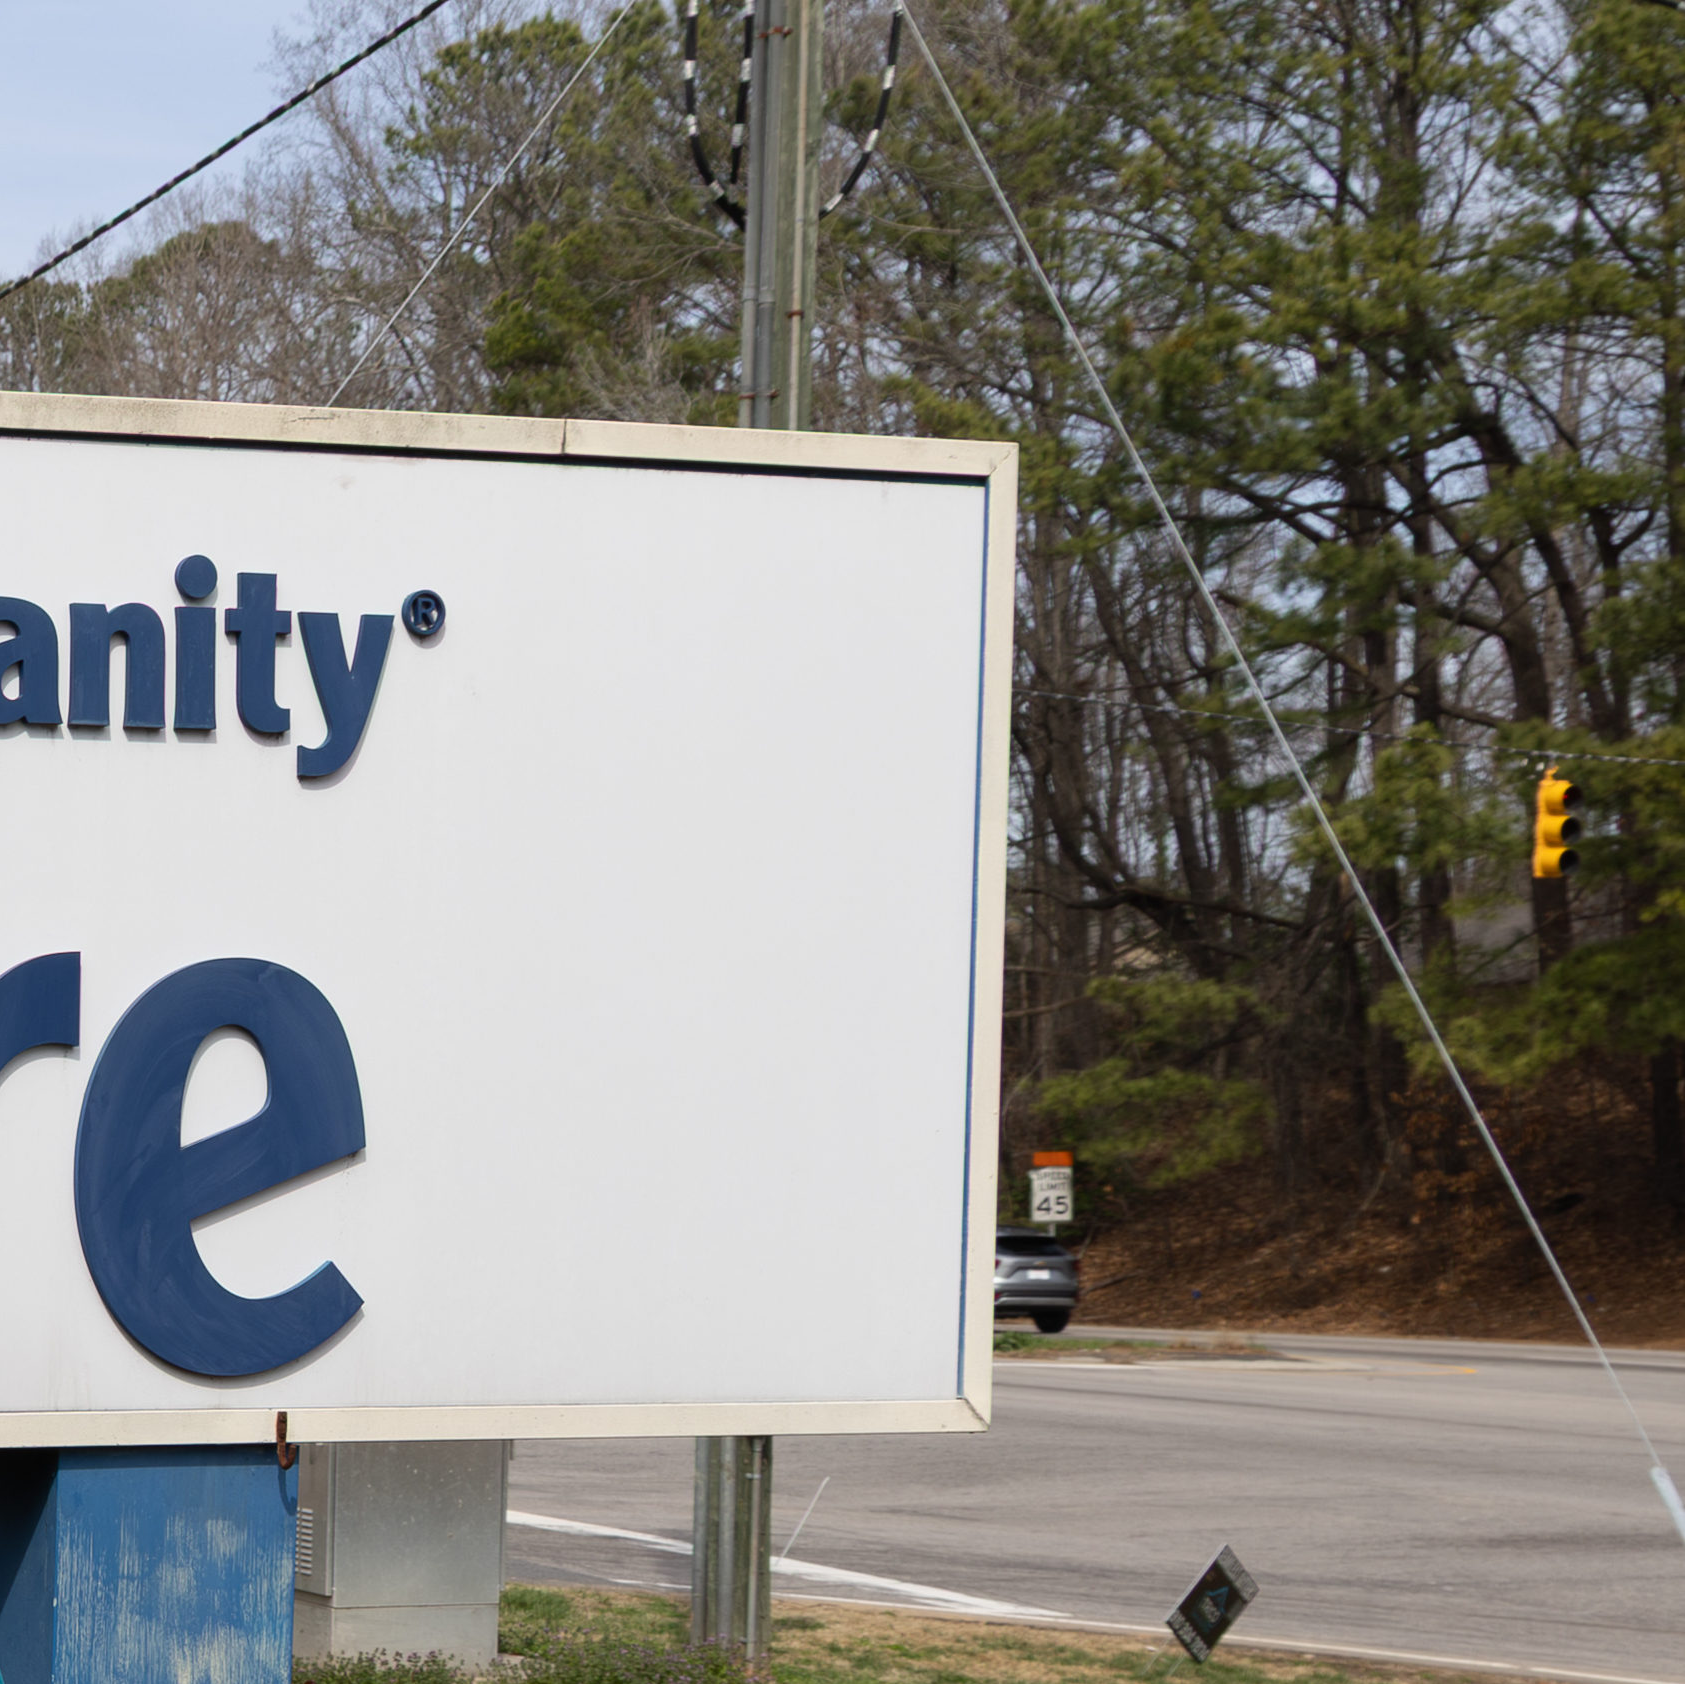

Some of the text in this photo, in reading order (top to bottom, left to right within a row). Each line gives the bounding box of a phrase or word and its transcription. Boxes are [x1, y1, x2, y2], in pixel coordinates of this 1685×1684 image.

[1036, 1171, 1070, 1180] SPEED
[1040, 1182, 1067, 1191] LIMIT
[1036, 1195, 1069, 1215] 45
